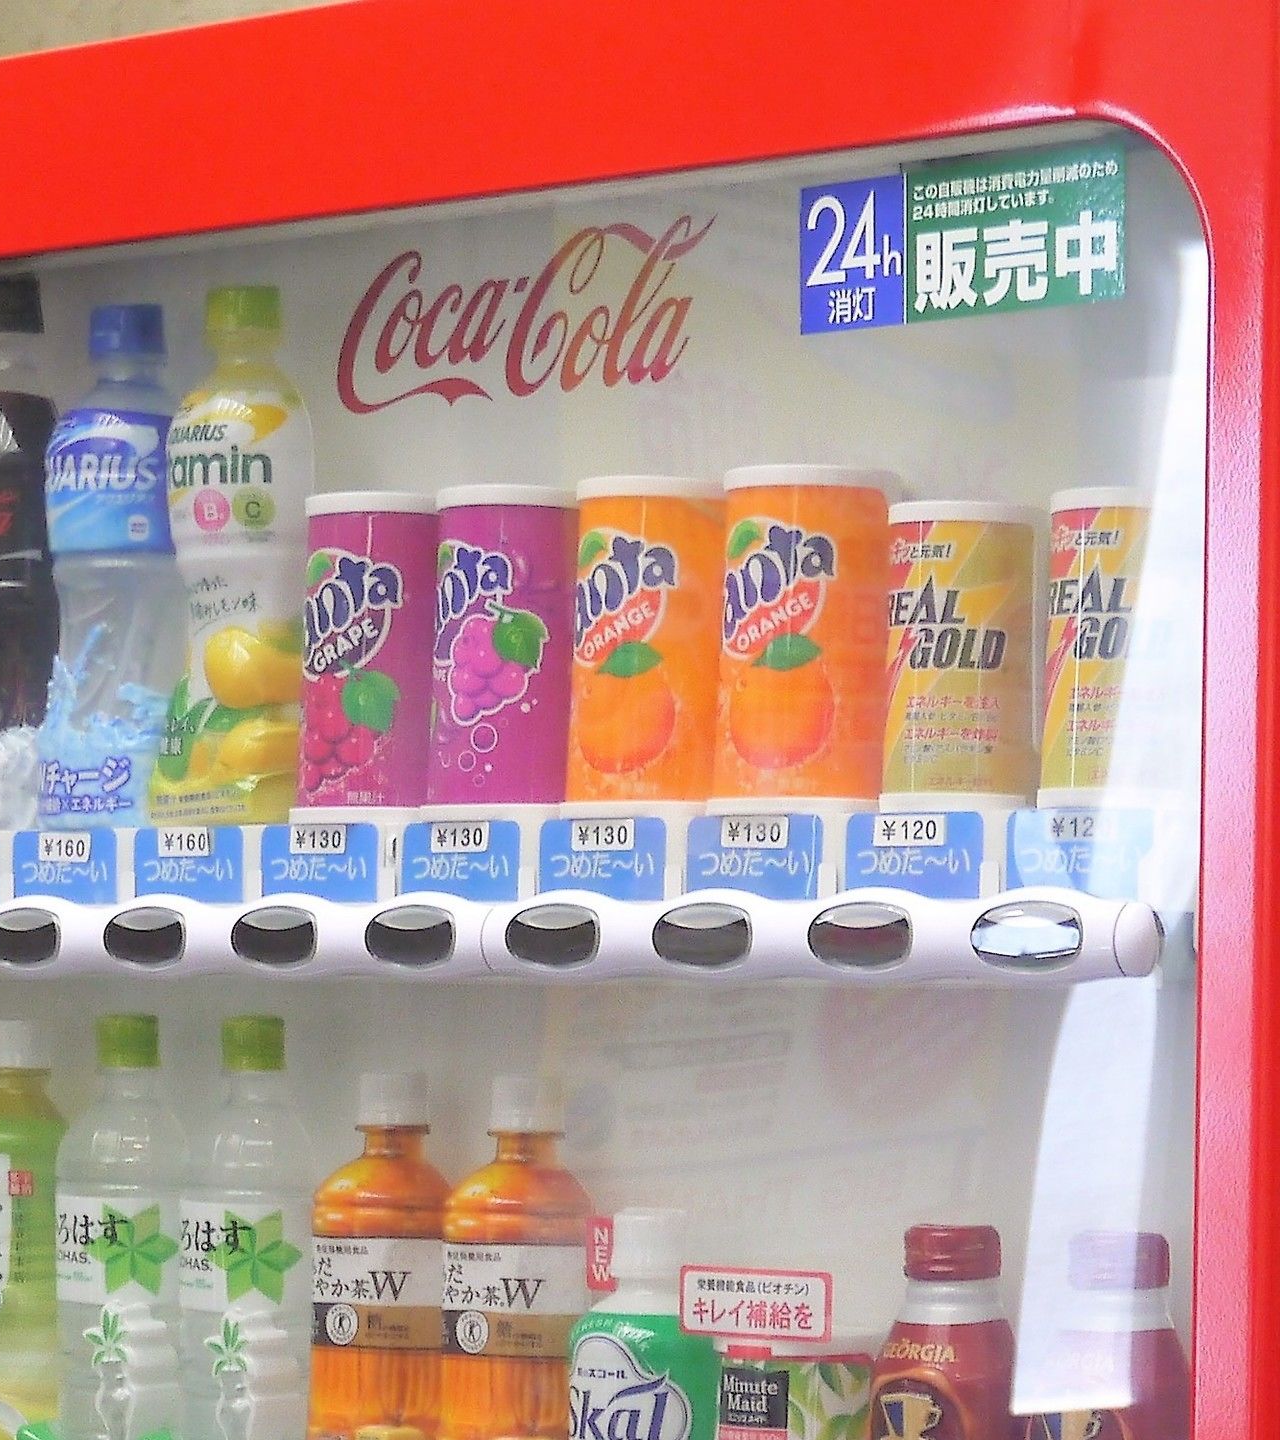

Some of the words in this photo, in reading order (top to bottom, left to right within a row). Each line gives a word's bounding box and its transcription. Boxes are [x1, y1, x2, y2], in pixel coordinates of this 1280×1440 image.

[913, 190, 1054, 220] 24時間消灯しています。
[807, 190, 903, 287] 24h
[914, 211, 1117, 313] 販売中
[336, 211, 719, 414] Coca-Cola
[827, 286, 876, 324] 消灯
[889, 573, 966, 627] EAL
[582, 601, 657, 661] ORANGE
[736, 591, 815, 652] ORANGE
[312, 617, 380, 674] GRAPE
[909, 627, 1007, 671] GOLD
[164, 832, 208, 853] ¥160
[295, 829, 342, 850] ¥130
[437, 827, 484, 848] ¥130
[578, 825, 629, 846] ¥130
[727, 821, 782, 844] ¥130
[882, 820, 938, 842] ¥120
[44, 838, 86, 858] ¥160
[591, 1227, 610, 1281] NEW
[692, 1298, 814, 1330] キレイ補給を
[723, 1374, 779, 1396] Minute
[728, 1394, 770, 1414] Maid
